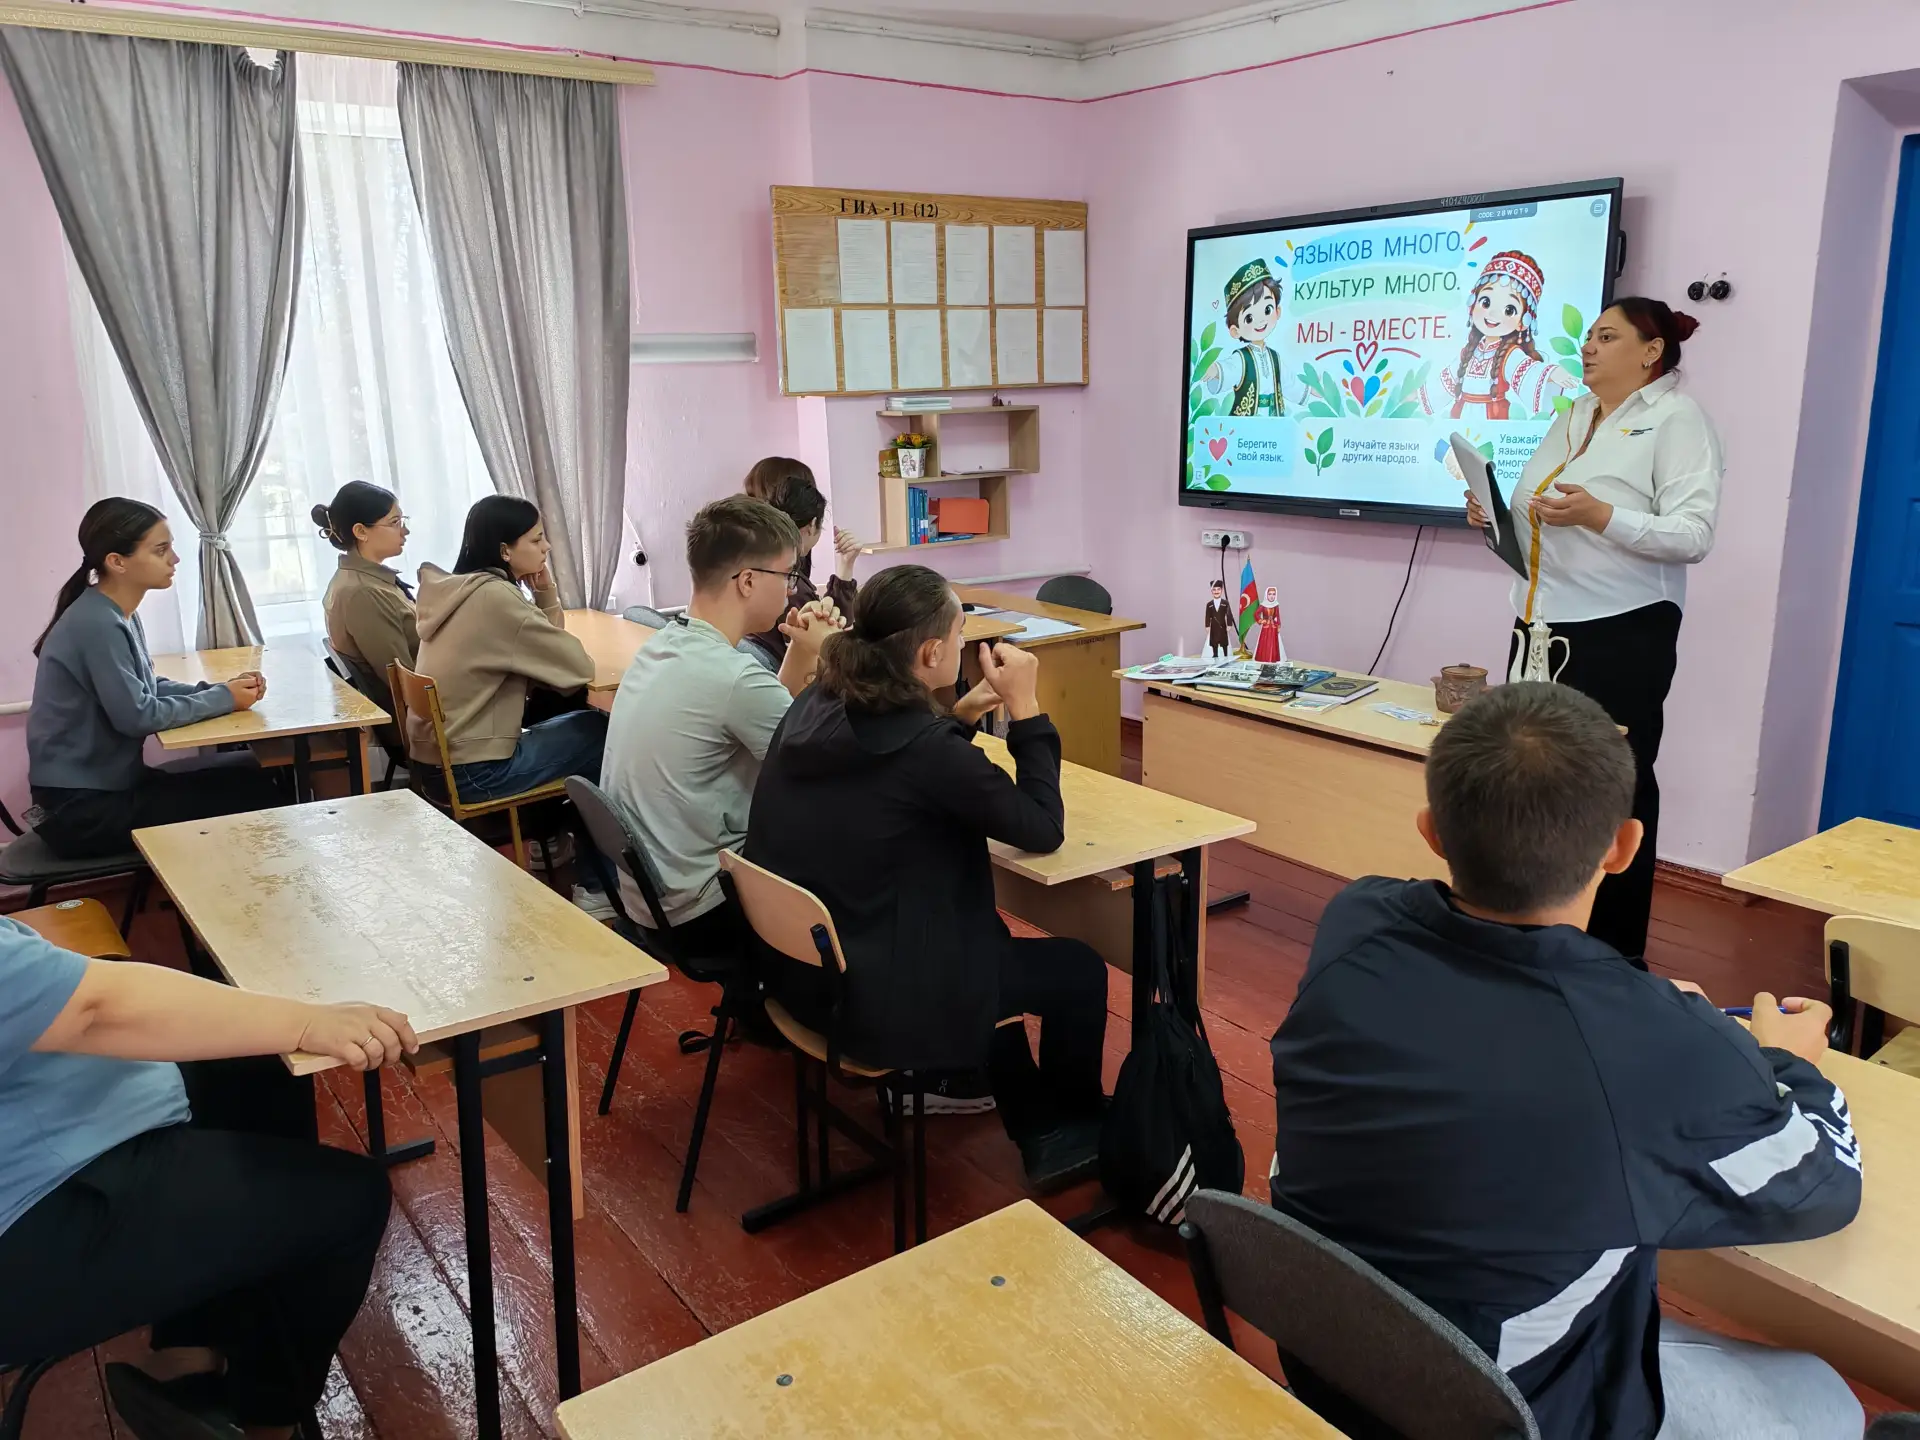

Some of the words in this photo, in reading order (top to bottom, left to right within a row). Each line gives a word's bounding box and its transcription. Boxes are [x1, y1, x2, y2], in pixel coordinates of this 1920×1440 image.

[913, 202, 939, 218] (12)
[1293, 239, 1373, 266] ЯЗЫКОВ
[1384, 230, 1465, 258] МНОГО.
[1294, 277, 1375, 301] КУЛЬТУР
[1384, 271, 1461, 295] МНОГО.
[1296, 321, 1334, 344] МЫ
[1352, 315, 1452, 342] ВМЕСТЕ.
[1237, 438, 1278, 450] Берегите
[1343, 439, 1387, 451] Изучайте
[1388, 442, 1420, 451] языки
[1499, 433, 1544, 445] Уважайт
[1236, 451, 1258, 461] свой
[1259, 453, 1285, 463] язык.
[1498, 447, 1536, 456] языков
[1341, 453, 1373, 464] других
[1375, 454, 1420, 464] народов.
[1496, 468, 1521, 480] Росс
